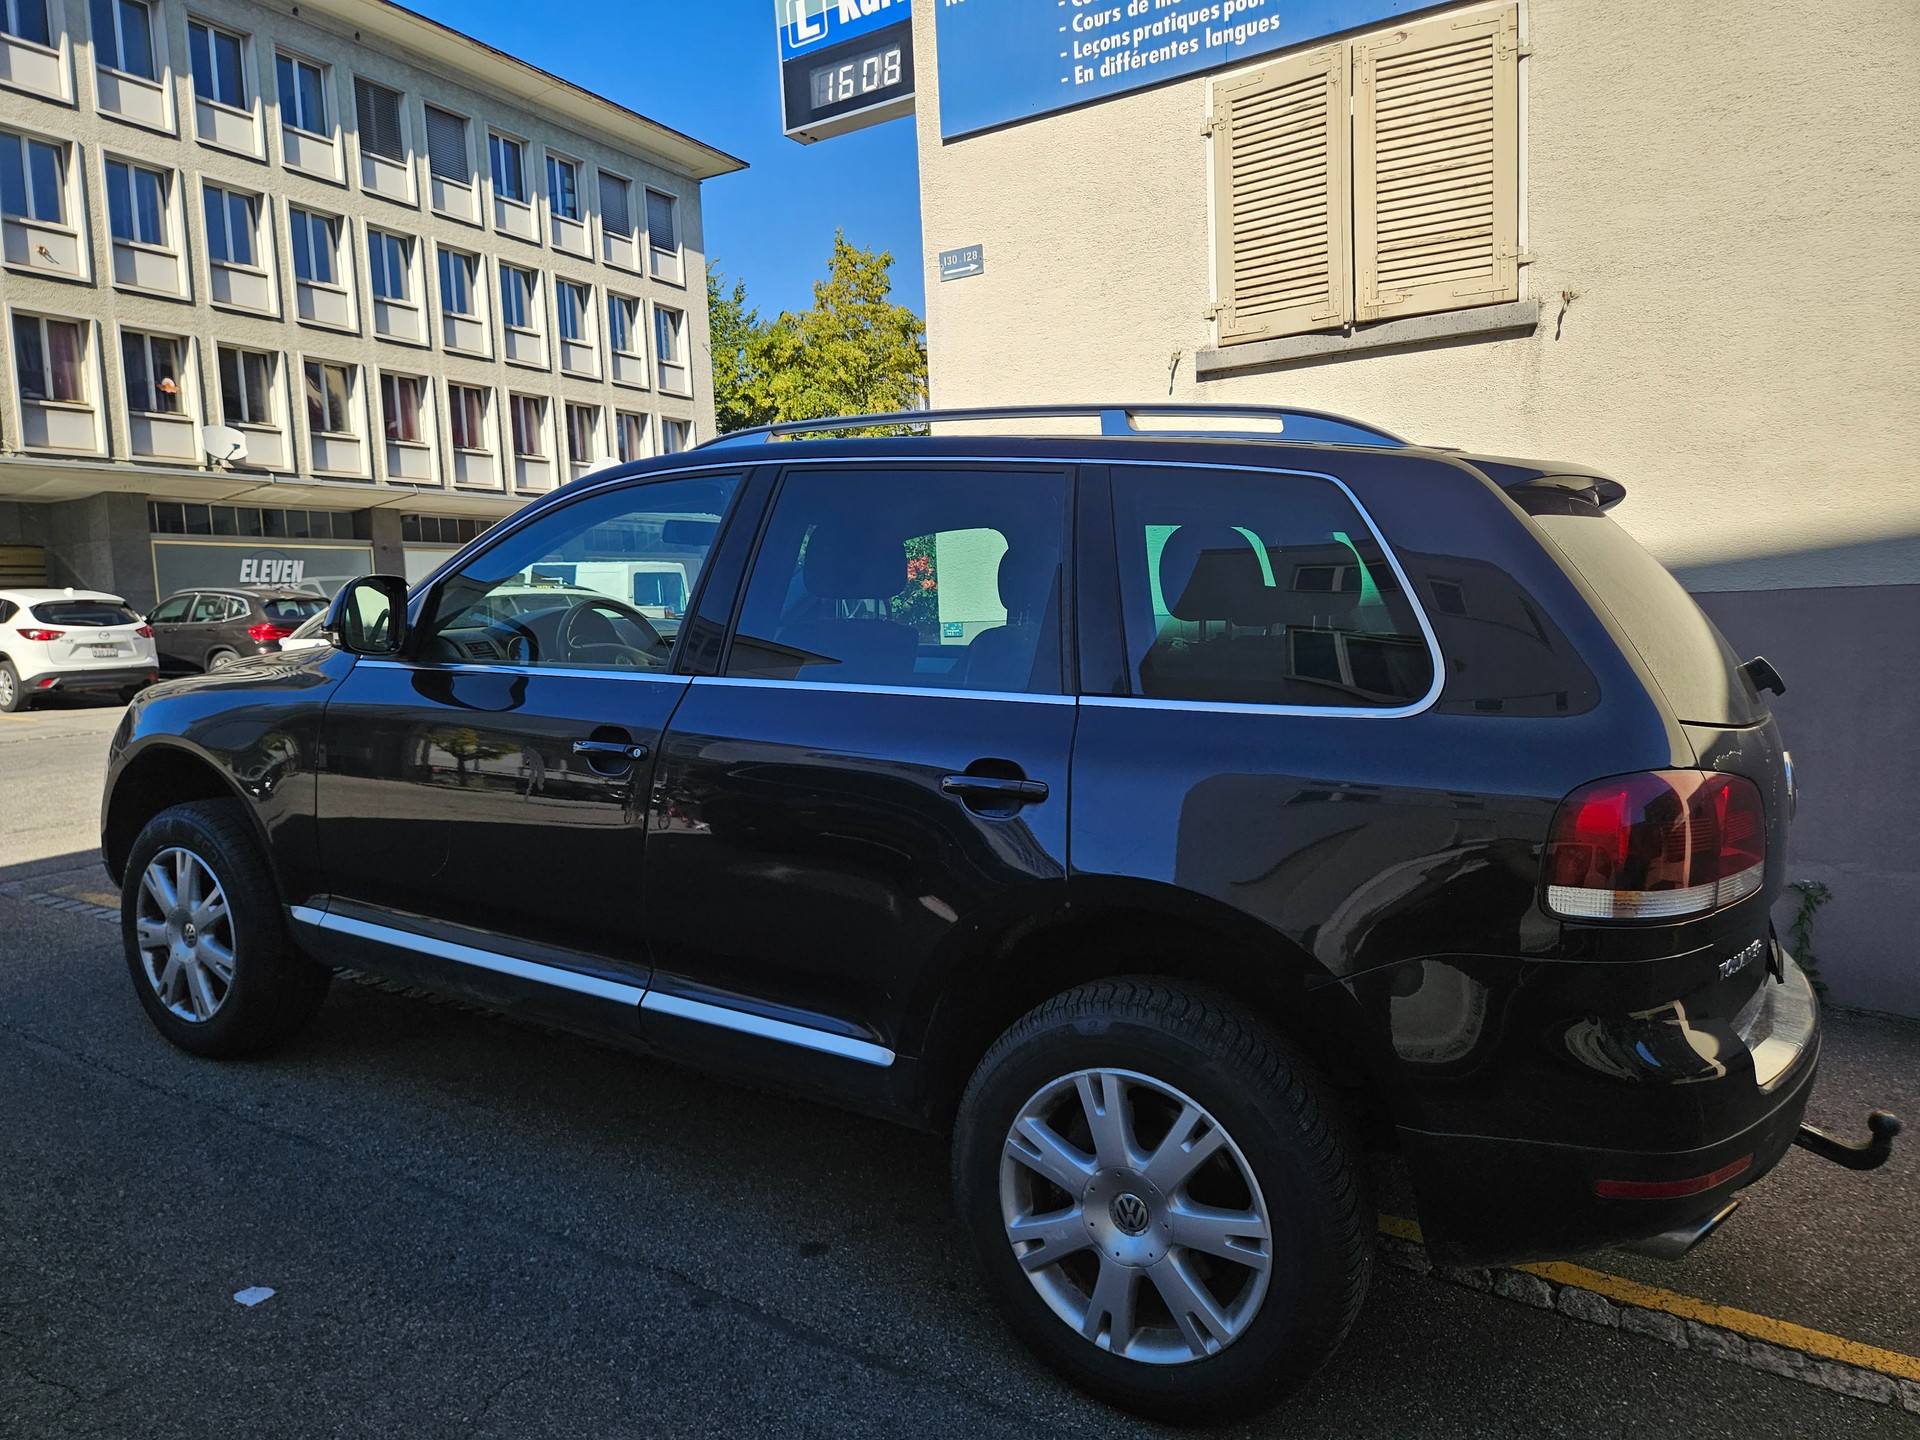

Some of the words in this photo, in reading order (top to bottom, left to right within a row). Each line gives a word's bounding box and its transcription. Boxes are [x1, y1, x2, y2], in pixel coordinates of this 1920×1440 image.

[1072, 7, 1122, 33] Cours
[1127, 0, 1149, 17] de
[1073, 31, 1131, 59] Leçons
[1133, 4, 1220, 48] pratiques
[1074, 65, 1094, 85] En
[1100, 38, 1199, 78] différentes
[1205, 14, 1280, 48] langues
[240, 559, 304, 583] ELEVEN
